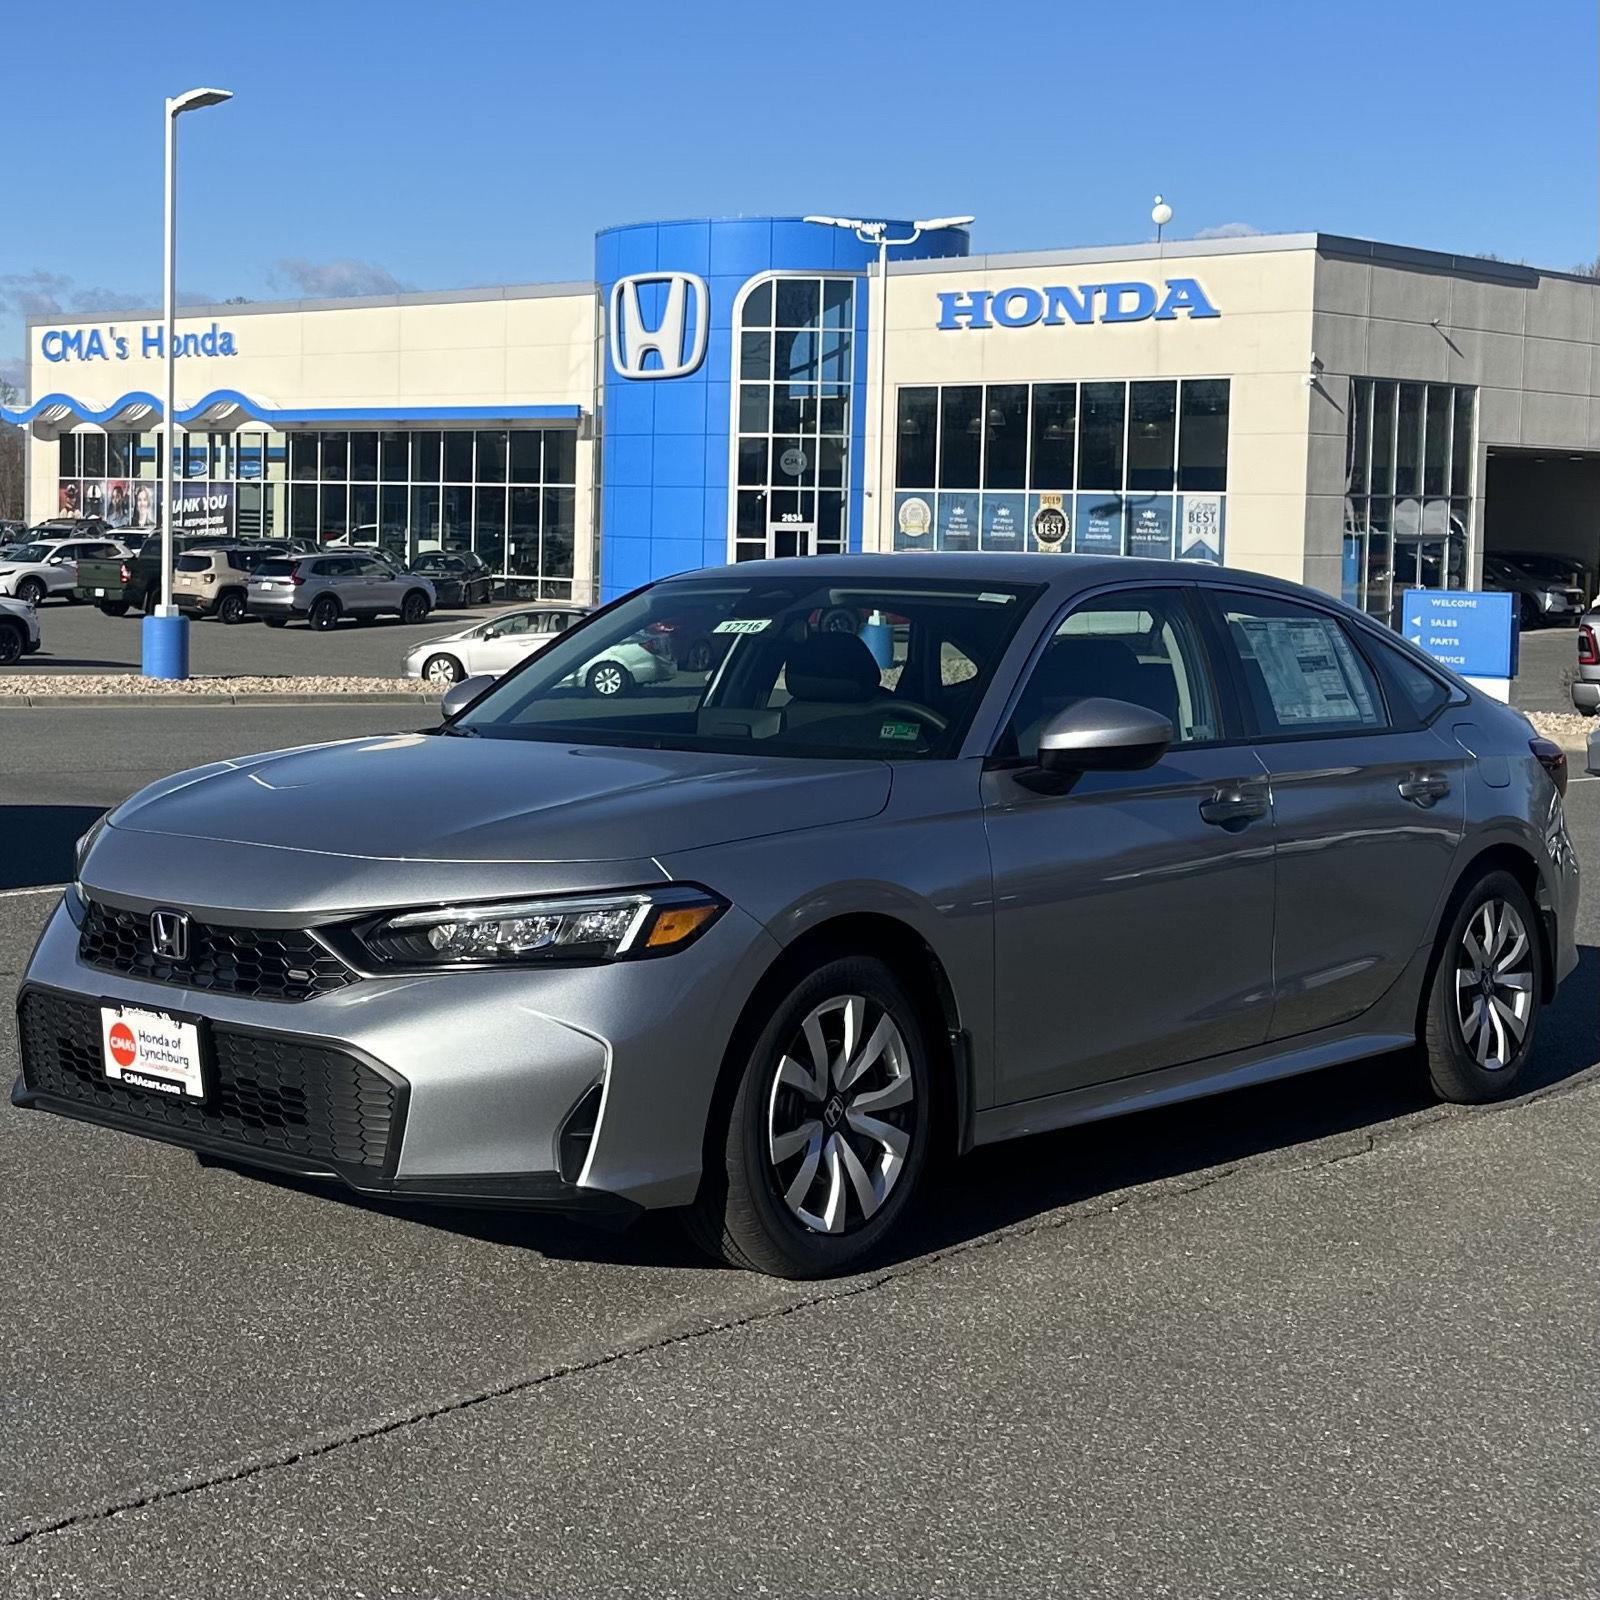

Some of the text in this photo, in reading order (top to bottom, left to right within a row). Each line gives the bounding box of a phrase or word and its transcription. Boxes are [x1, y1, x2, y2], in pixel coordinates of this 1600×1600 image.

[936, 278, 1221, 330] HONDA
[42, 323, 238, 363] CMA's Honda
[203, 495, 228, 510] YOU
[1041, 495, 1061, 505] 2019
[1188, 511, 1216, 523] BEST
[1038, 522, 1063, 535] BEST
[1188, 525, 1217, 535] 2020
[1431, 599, 1478, 609] WELCOME
[1430, 619, 1458, 628] SALES
[1429, 637, 1460, 647] PARTS
[1433, 655, 1466, 665] ERVICE
[138, 1030, 182, 1050] Honda of
[139, 1045, 190, 1070] Lynchburg
